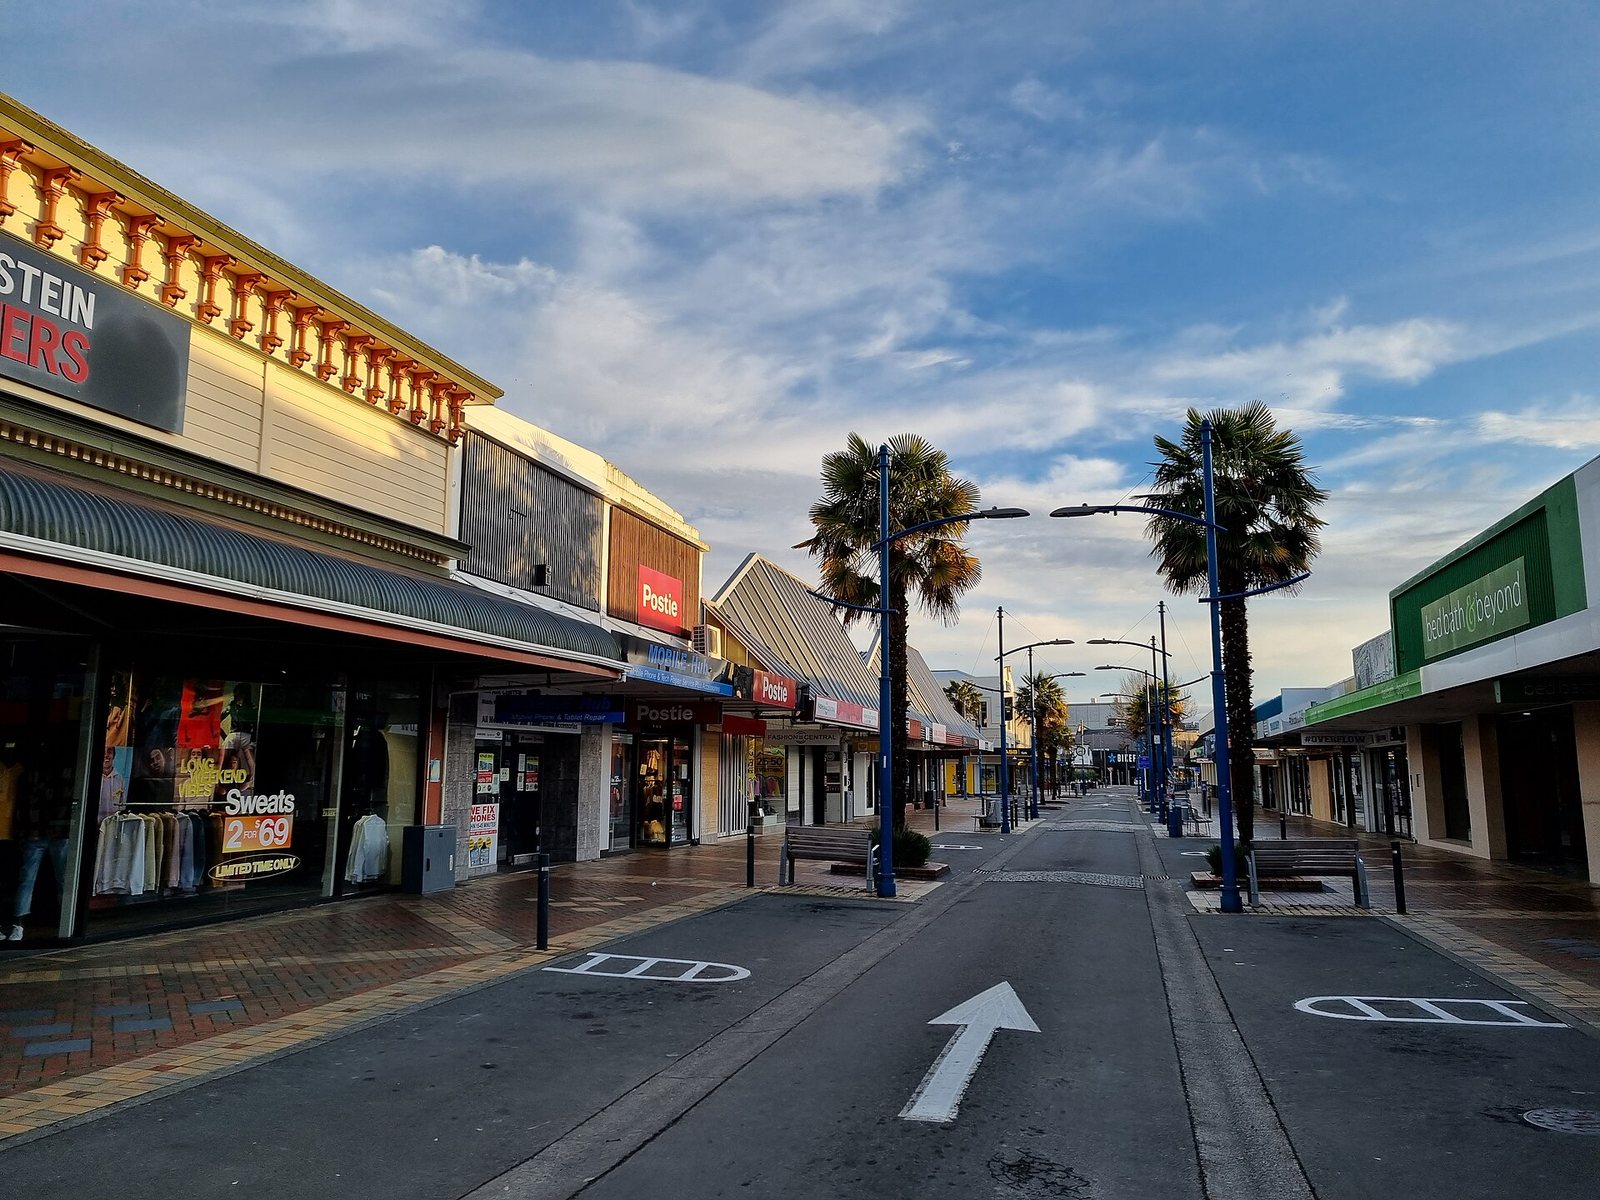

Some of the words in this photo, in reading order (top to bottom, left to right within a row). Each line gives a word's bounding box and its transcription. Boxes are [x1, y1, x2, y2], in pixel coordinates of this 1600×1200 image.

[0, 252, 95, 330] STEIN
[643, 583, 678, 618] Postie
[1426, 607, 1442, 642] bed
[1442, 599, 1466, 635] bath
[1475, 571, 1522, 627] beyond
[648, 644, 688, 671] MOBILE
[691, 656, 709, 676] Hub
[762, 677, 788, 702] Postie
[584, 714, 606, 722] Repair
[637, 705, 694, 721] Postie
[1304, 734, 1366, 744] #OVERFLOW
[180, 757, 215, 774] LONG
[190, 768, 248, 785] WEEKEND
[178, 782, 213, 798] VIBES
[225, 788, 296, 816] Sweats
[483, 805, 495, 814] FIX
[225, 820, 244, 849] 2
[243, 830, 257, 840] FOR
[255, 817, 289, 847] $69
[215, 862, 251, 878] LIMITED
[252, 859, 274, 874] TIME
[274, 857, 296, 871] ONLY
